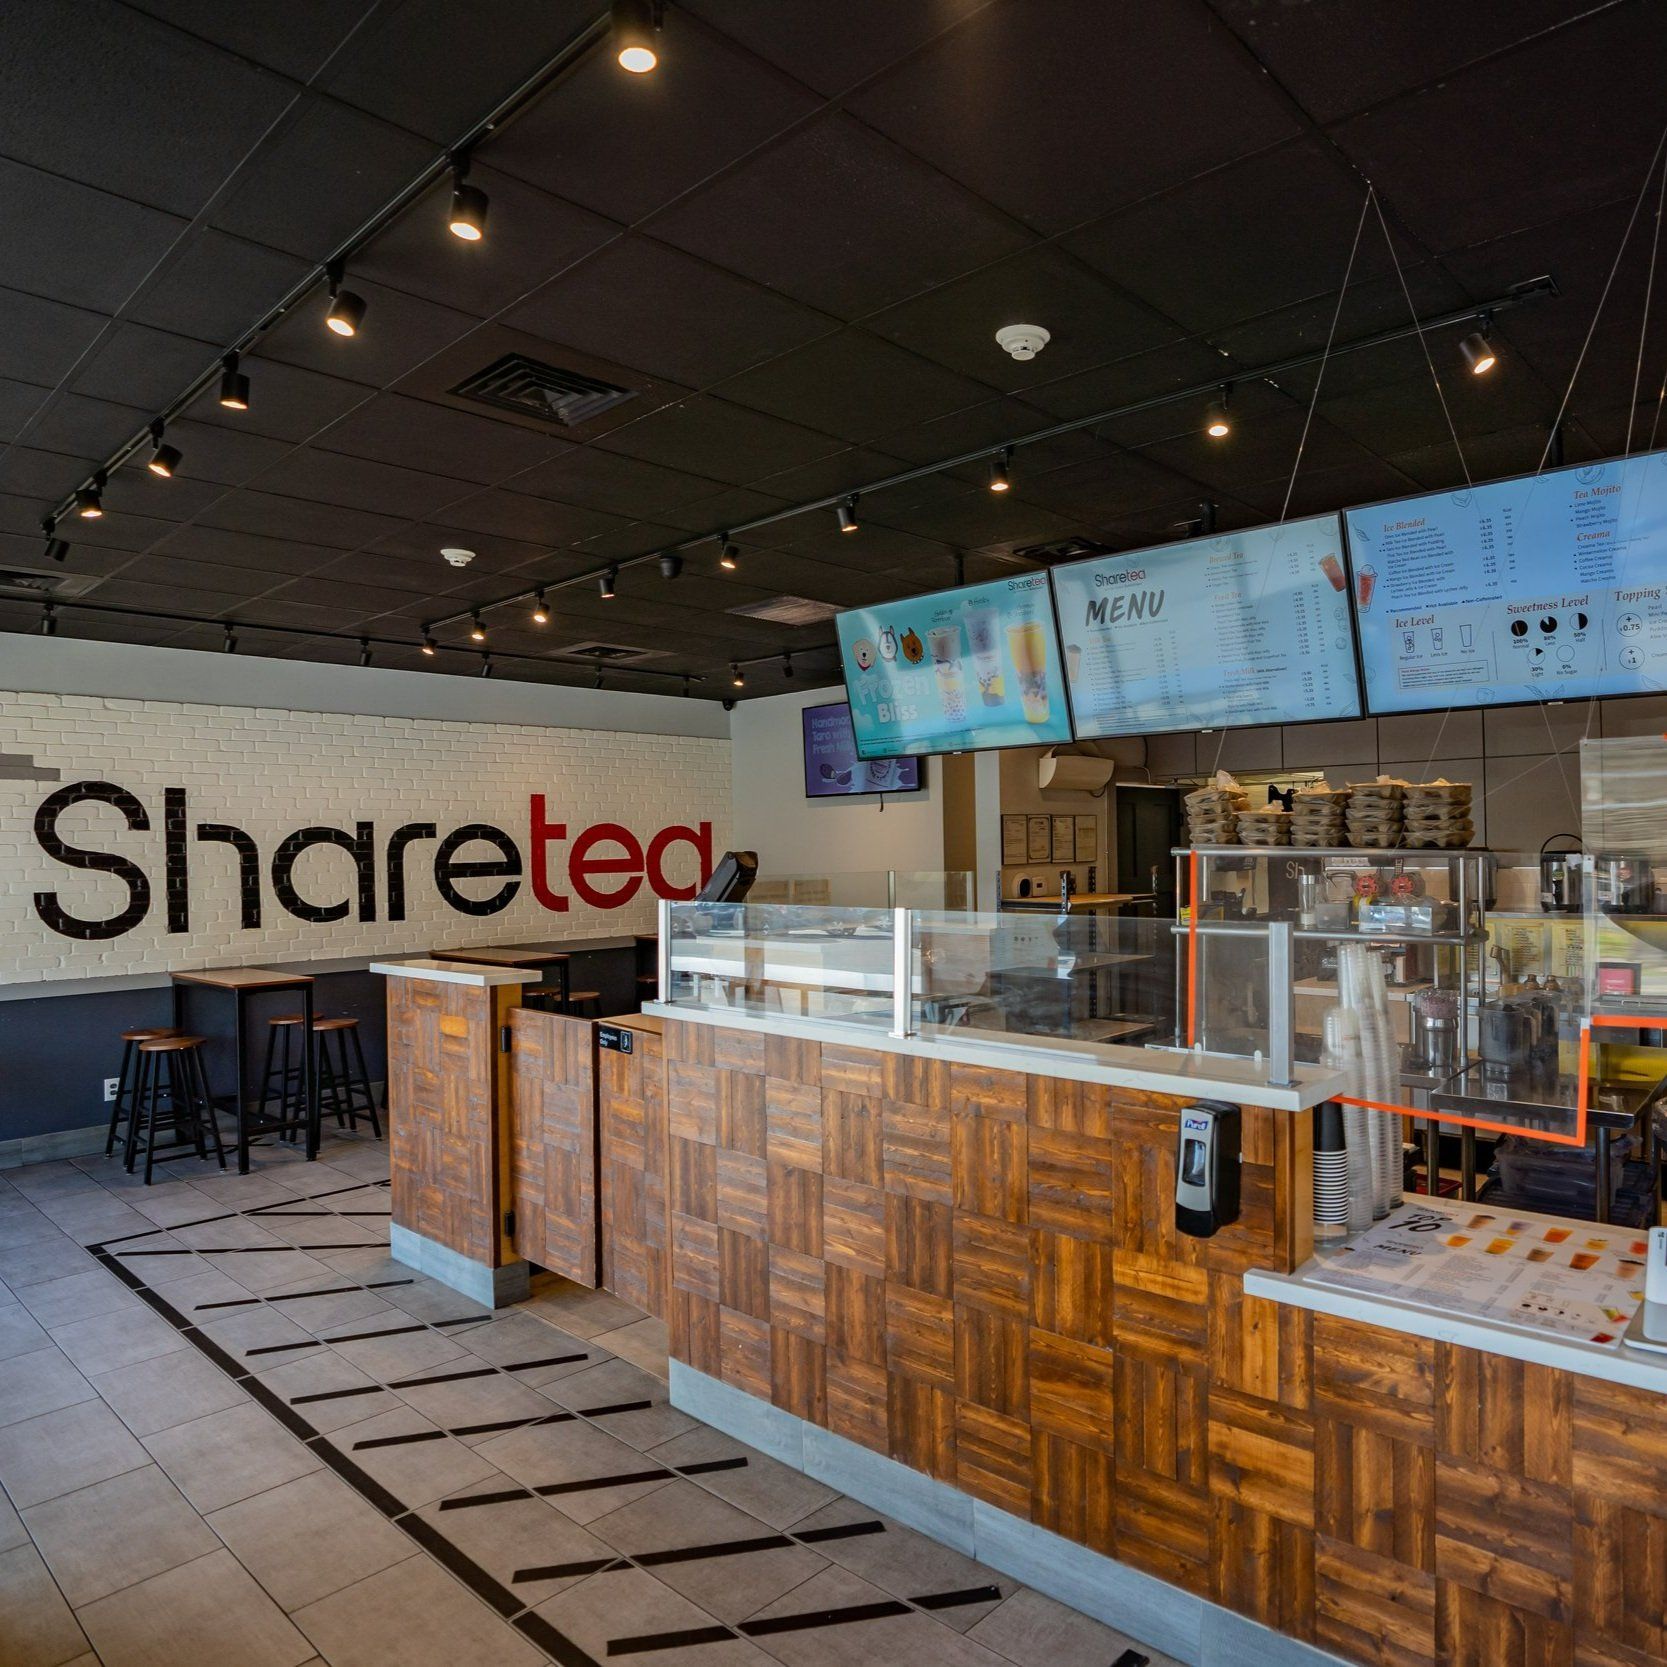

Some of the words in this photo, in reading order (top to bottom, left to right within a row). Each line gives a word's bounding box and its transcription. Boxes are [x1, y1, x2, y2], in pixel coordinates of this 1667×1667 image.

[1575, 490, 1588, 500] Tea
[1591, 484, 1622, 497] Mojito
[1396, 518, 1425, 530] Blended
[1577, 529, 1610, 540] Creama
[1007, 577, 1049, 592] Sharetea
[1095, 568, 1146, 587] Sharetea
[1615, 587, 1661, 605] Topping
[1085, 590, 1165, 627] MENU
[1507, 600, 1558, 614] Sweetness
[1562, 596, 1589, 608] Level
[1395, 618, 1408, 628] Ice
[1411, 615, 1435, 626] Level
[877, 702, 918, 724] Bliss
[34, 780, 713, 941] Sharetea
[1408, 1213, 1453, 1223] TOP
[1387, 1220, 1442, 1233] 10
[1373, 1243, 1423, 1257] MENU
